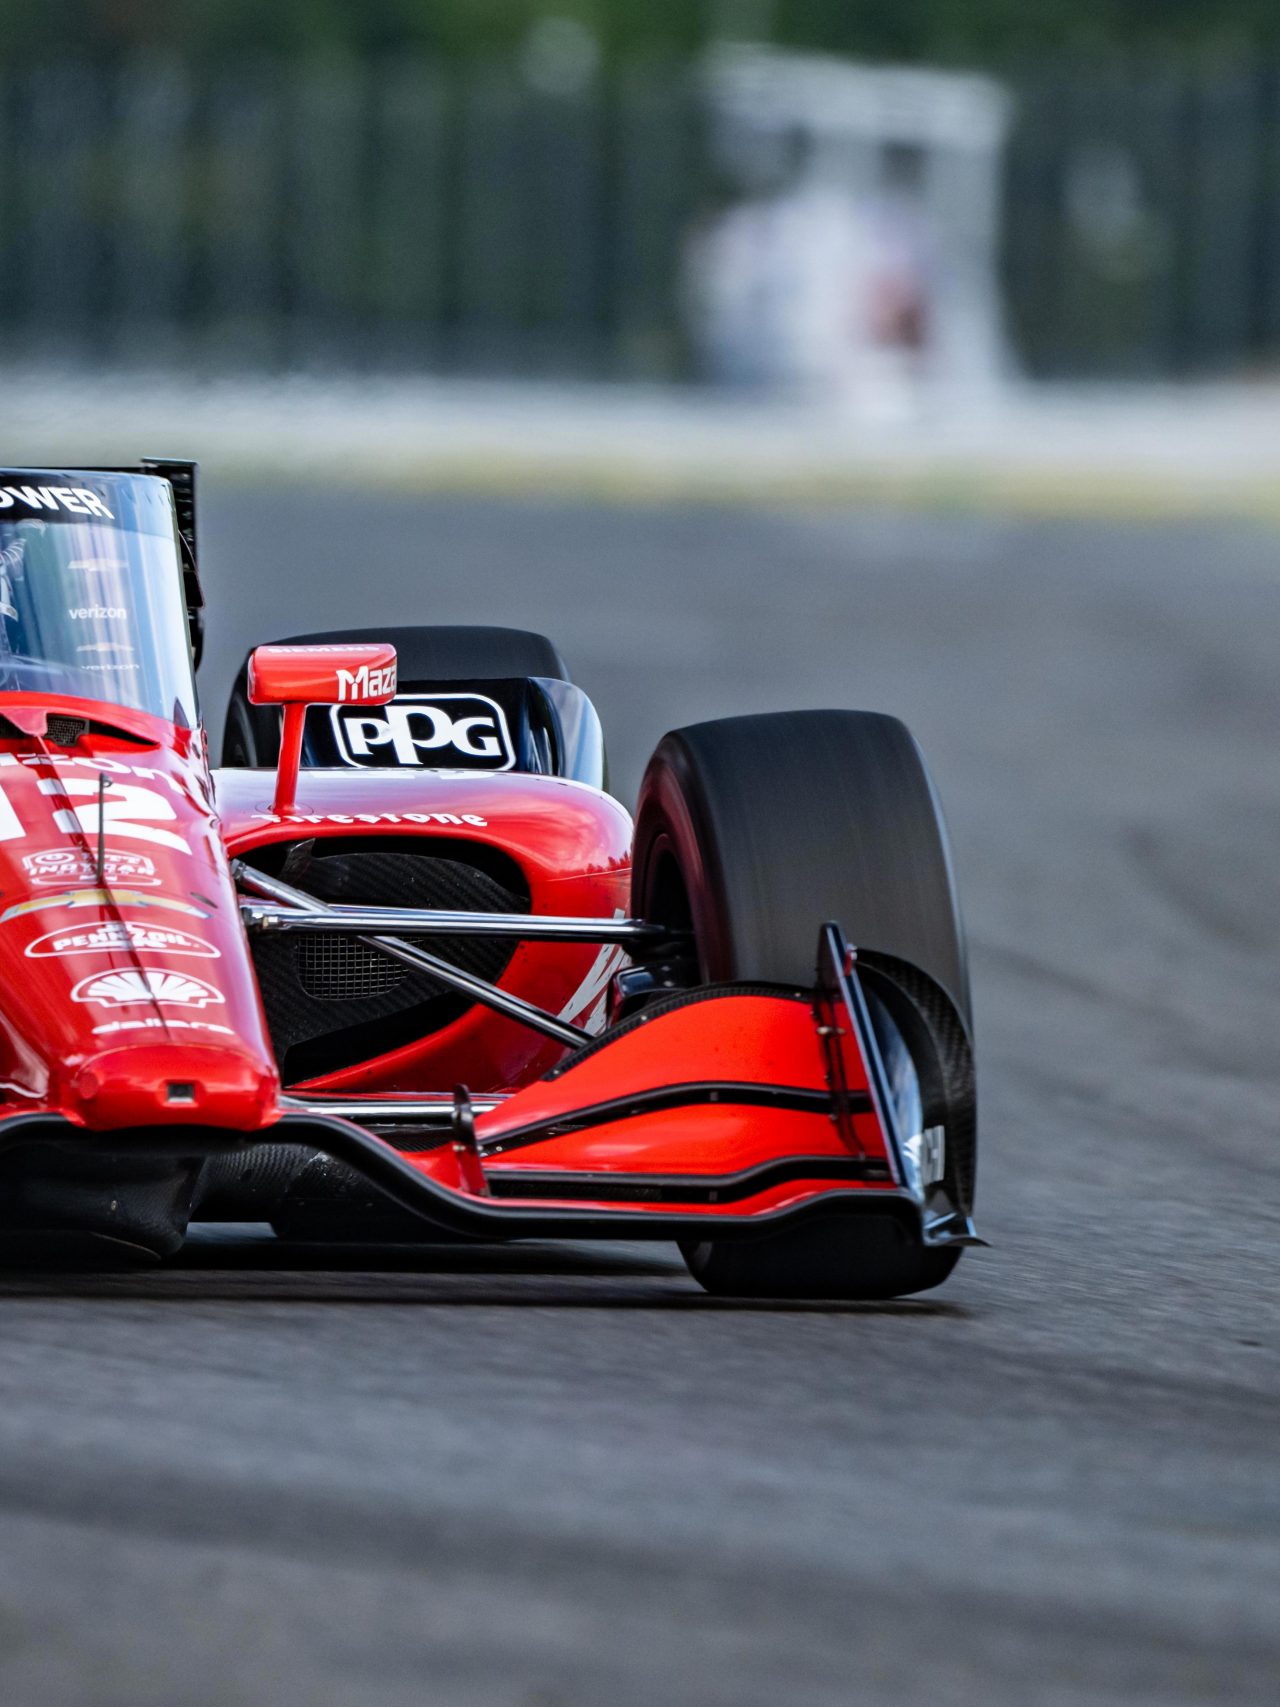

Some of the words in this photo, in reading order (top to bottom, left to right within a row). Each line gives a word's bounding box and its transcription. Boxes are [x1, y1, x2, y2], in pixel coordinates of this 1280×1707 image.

[68, 604, 127, 619] verizon
[343, 705, 503, 765] PPG
[251, 814, 488, 827] Firestone
[52, 922, 192, 951] PENNZOIL
